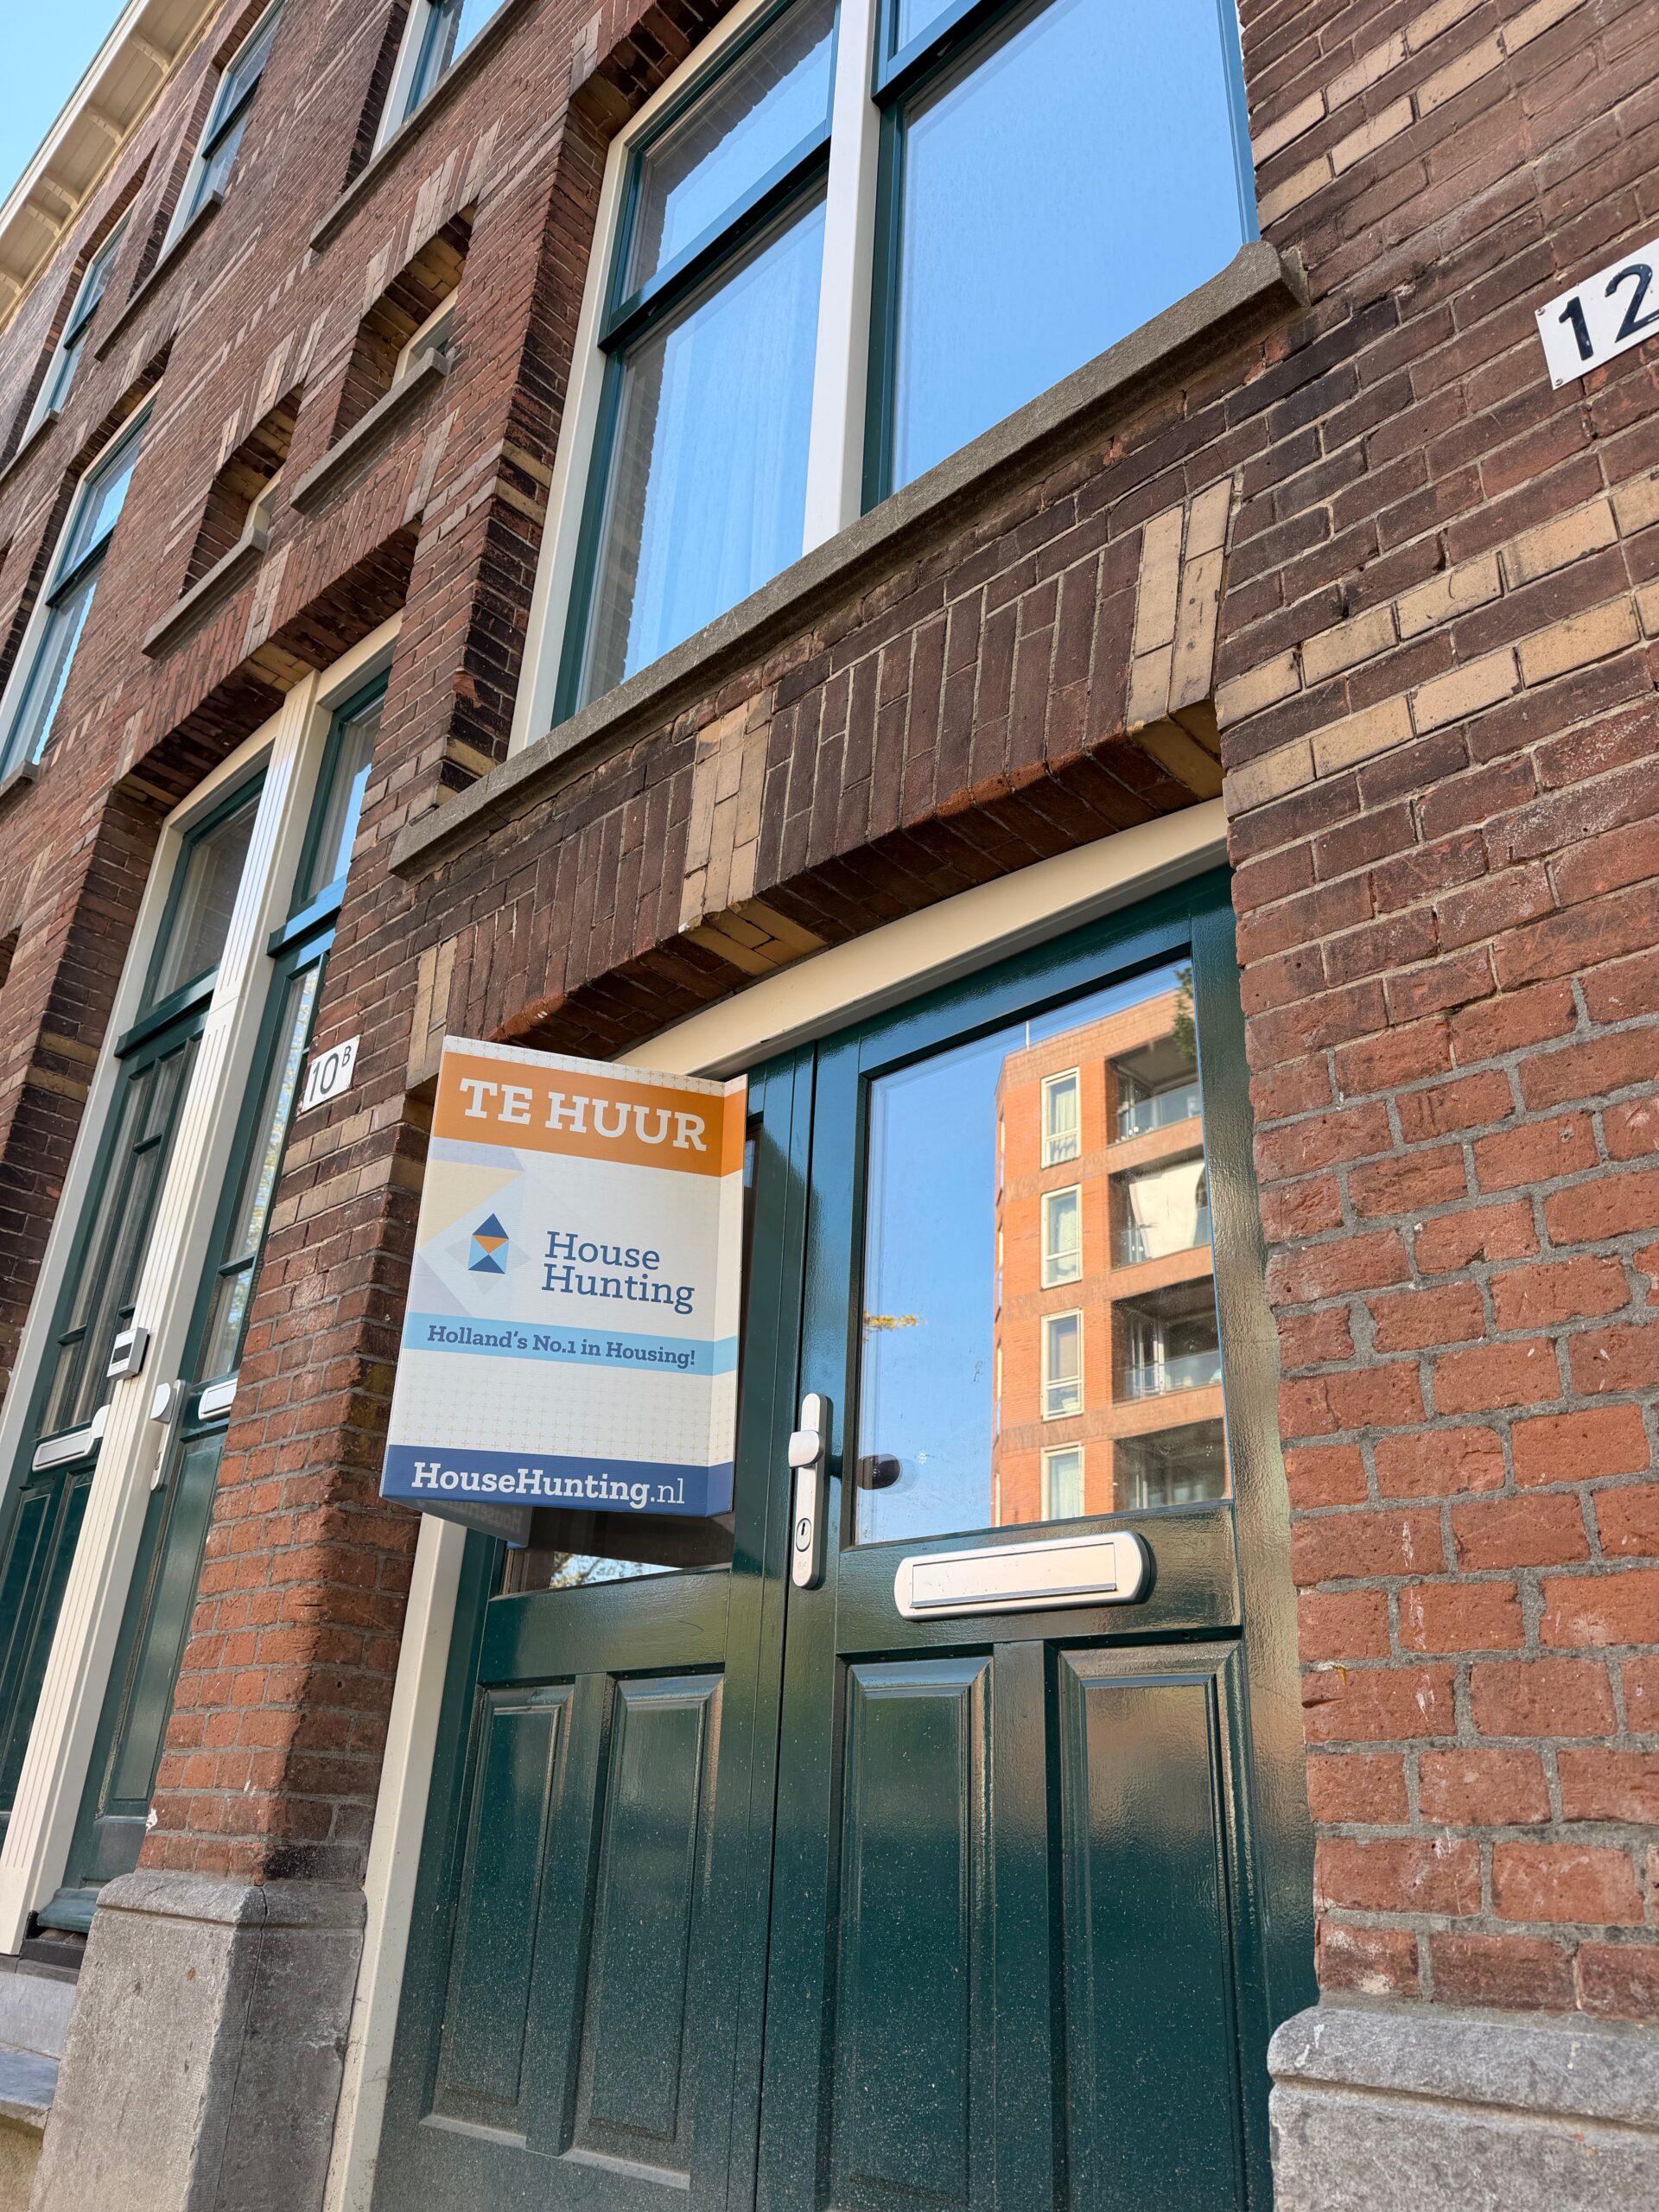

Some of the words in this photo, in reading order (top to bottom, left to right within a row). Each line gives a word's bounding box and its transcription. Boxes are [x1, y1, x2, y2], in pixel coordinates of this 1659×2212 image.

[1558, 264, 1659, 361] 12
[459, 1077, 533, 1126] TE
[544, 1091, 708, 1152] HUUR
[543, 1230, 661, 1270] House
[541, 1262, 696, 1315] Hunting
[427, 1325, 528, 1351] Holland's
[531, 1334, 577, 1355] No.1
[580, 1338, 602, 1357] in
[605, 1341, 696, 1370] Housing!
[410, 1461, 686, 1509] HouseHunting.nl
